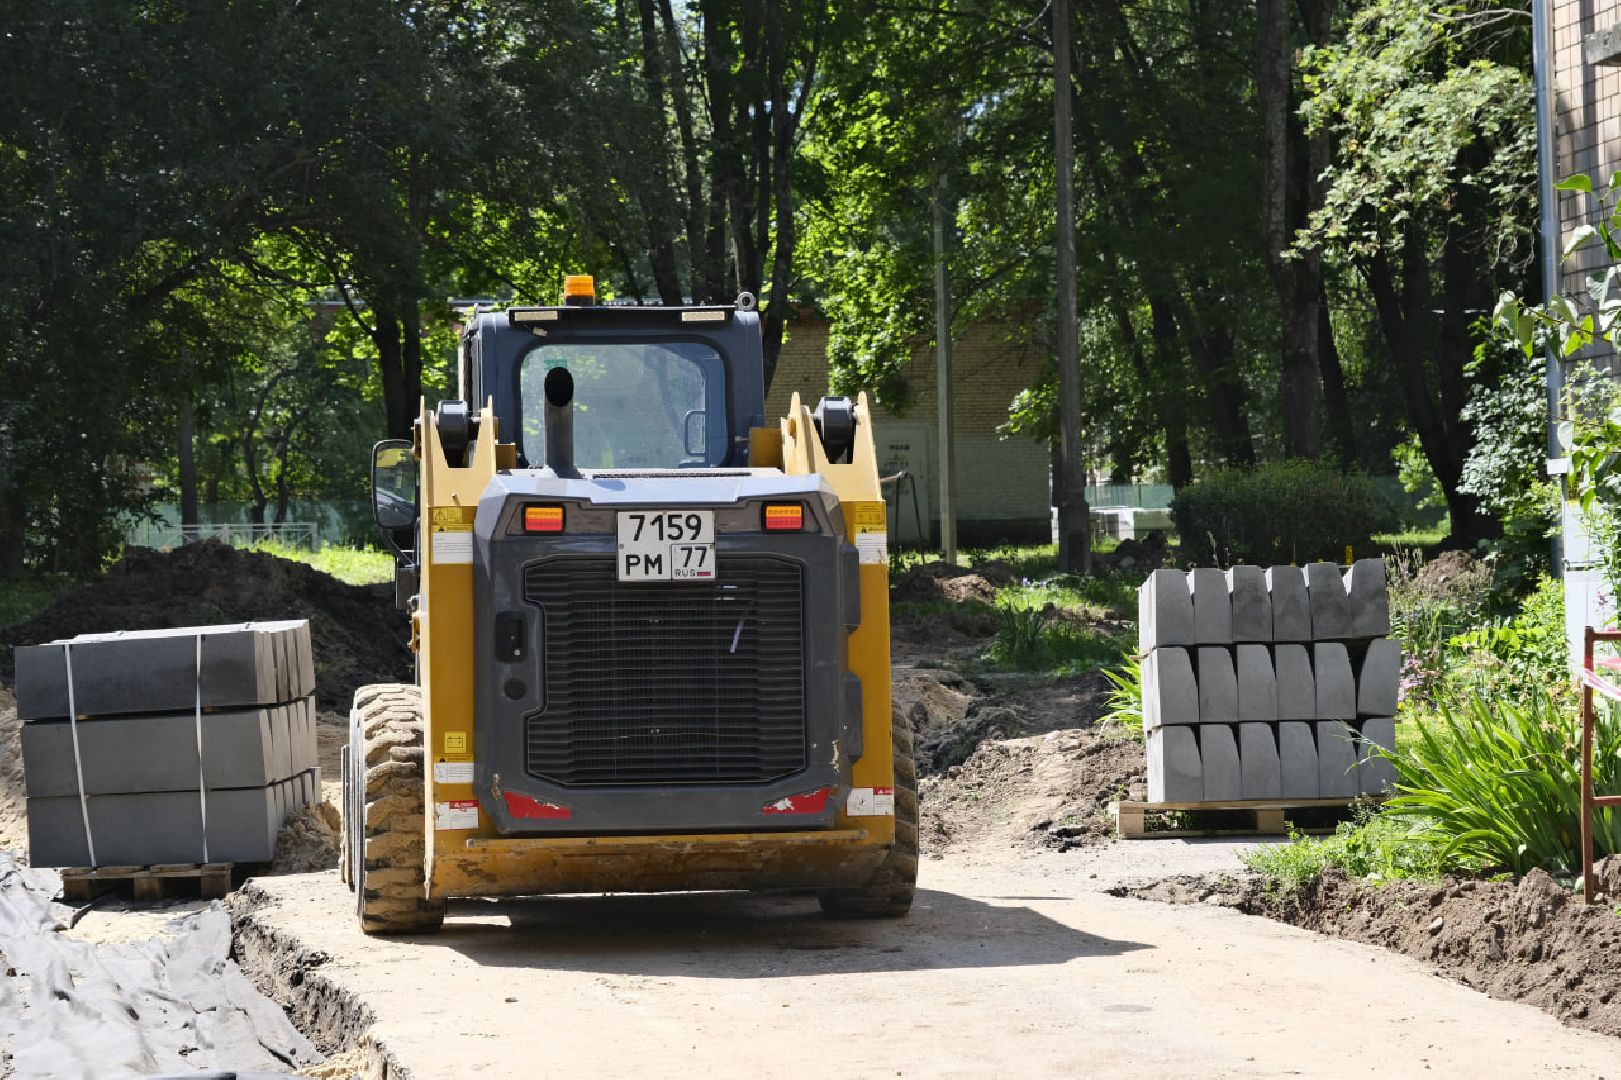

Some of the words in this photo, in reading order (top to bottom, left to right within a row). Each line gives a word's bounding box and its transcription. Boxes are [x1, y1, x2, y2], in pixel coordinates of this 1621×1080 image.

[629, 514, 702, 541] 7159
[680, 547, 707, 568] 77
[675, 569, 695, 577] RUS
